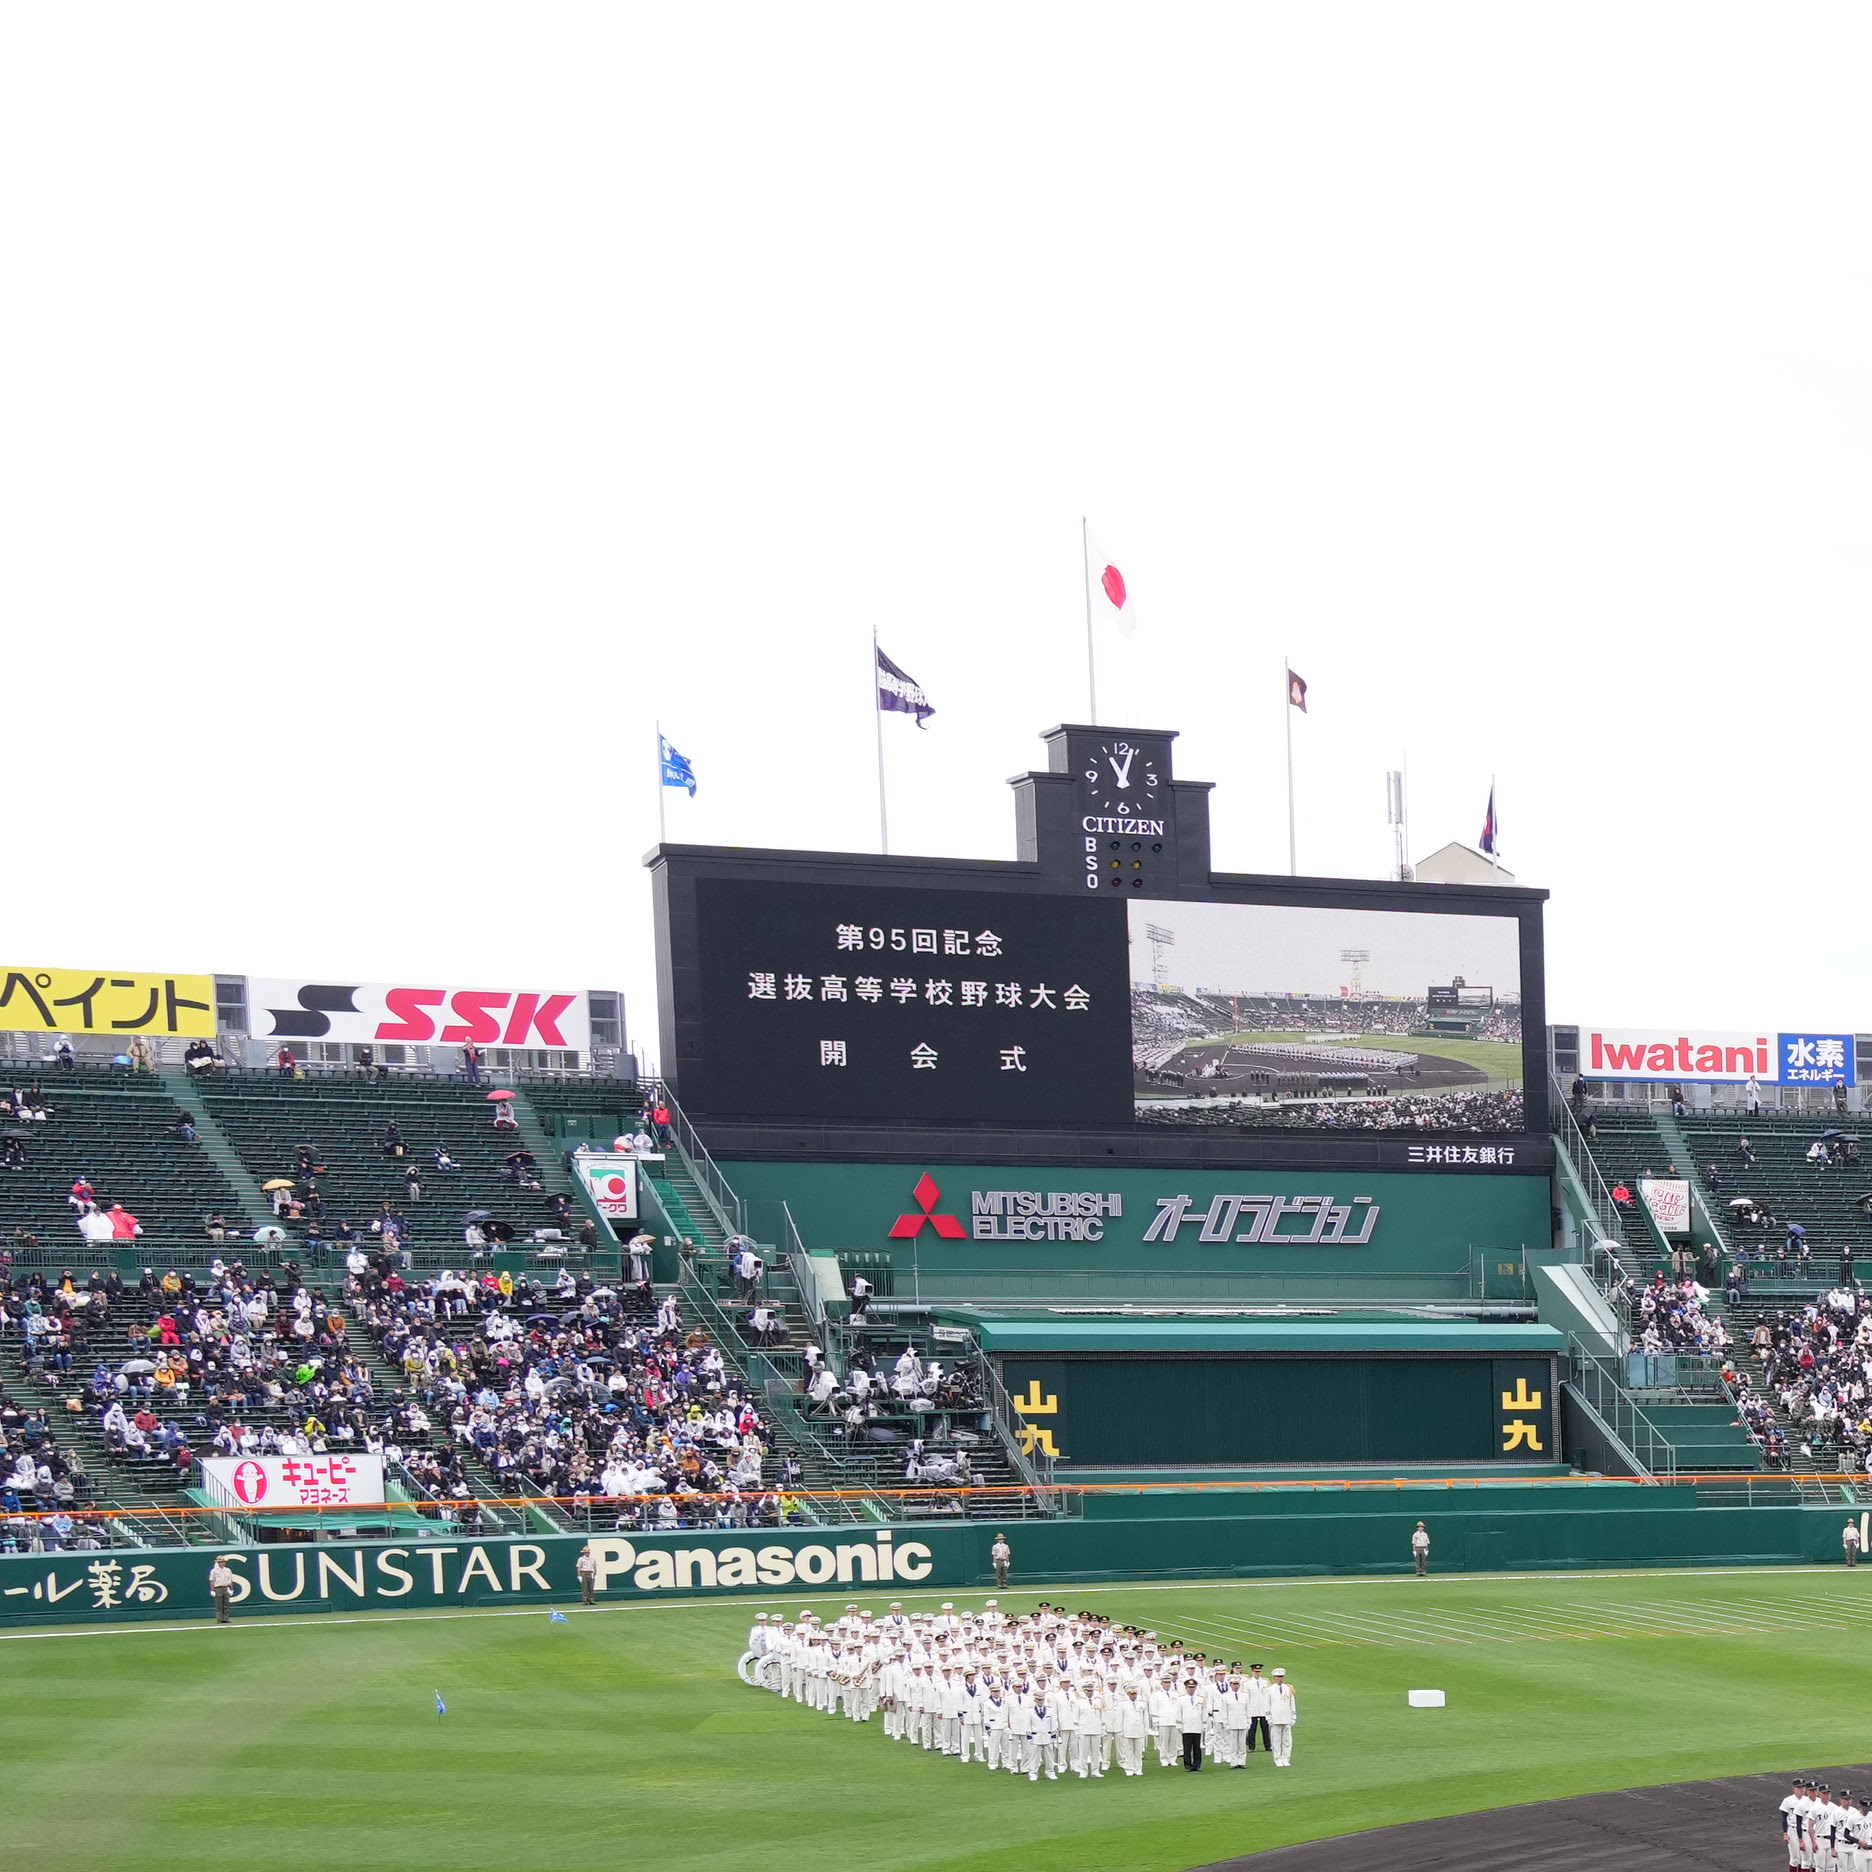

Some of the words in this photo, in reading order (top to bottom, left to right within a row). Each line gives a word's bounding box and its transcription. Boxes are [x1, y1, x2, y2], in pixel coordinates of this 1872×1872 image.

[1086, 770, 1098, 783] 9
[1146, 774, 1158, 786] 3
[1117, 802, 1130, 814] 6
[1082, 815, 1165, 836] CITIZEN
[1085, 836, 1097, 852] B
[1085, 855, 1098, 871] S
[835, 923, 1005, 958] 第95回記念
[0, 971, 210, 1033] ペイント
[747, 970, 1092, 1012] 選抜高等学校野球大会
[374, 988, 577, 1046] SSK
[1591, 1033, 1768, 1075] Iwatani
[1786, 1037, 1845, 1069] 水素
[1786, 1068, 1845, 1083] エネルギー
[1407, 1146, 1516, 1167] 三井住友銀行
[972, 1191, 1122, 1218] MITSUBISHI
[1142, 1195, 1381, 1245] オーロラビジョン
[972, 1215, 1105, 1242] ELECTRIC
[1014, 1379, 1061, 1458] 山九
[1501, 1377, 1544, 1452] 山九
[282, 1457, 357, 1488] キューピー
[298, 1487, 350, 1504] マヨネーズ
[227, 1544, 551, 1602] SUNSTAR
[589, 1530, 933, 1592] Panasonic
